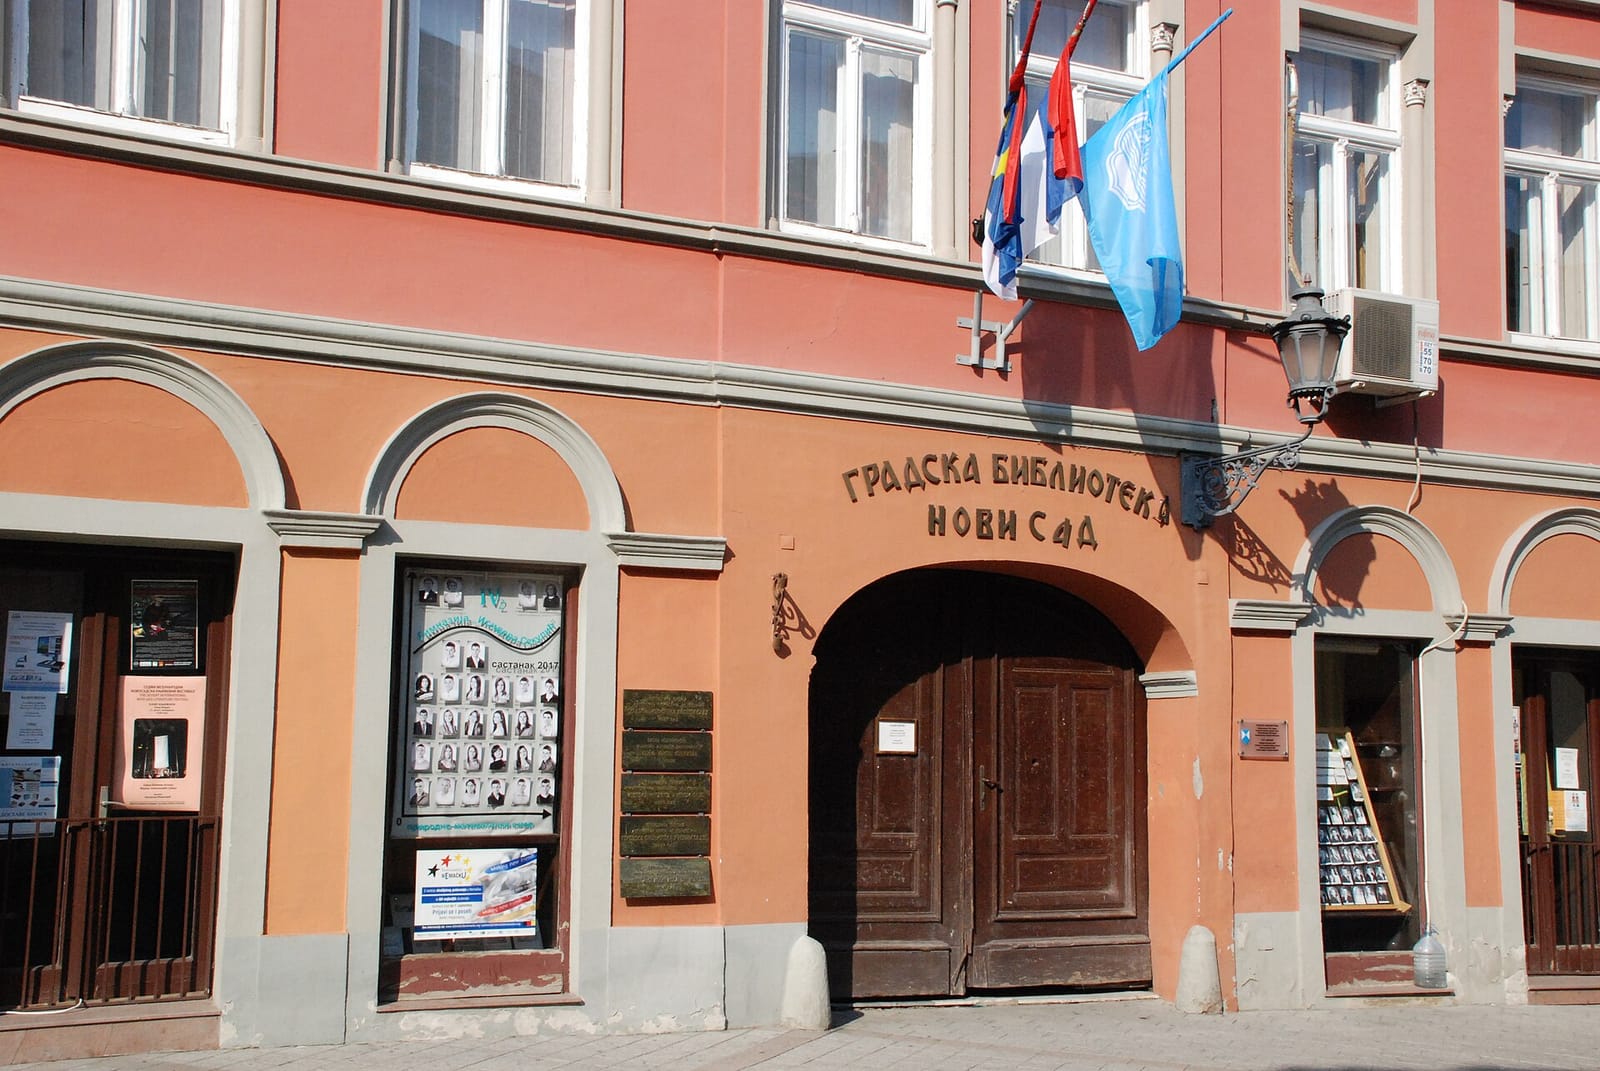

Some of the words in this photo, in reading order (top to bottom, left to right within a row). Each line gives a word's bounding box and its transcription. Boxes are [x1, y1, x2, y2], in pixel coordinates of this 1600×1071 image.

[1424, 348, 1433, 356] 55
[1424, 357, 1432, 365] 70
[1423, 366, 1432, 375] 70
[842, 452, 981, 503] ГРАДСКА
[991, 453, 1171, 528] БИБЛИОТЕКА
[927, 504, 1017, 541] НОВИ
[1028, 510, 1098, 551] САД
[491, 661, 535, 669] састанак
[537, 661, 559, 670] 2017
